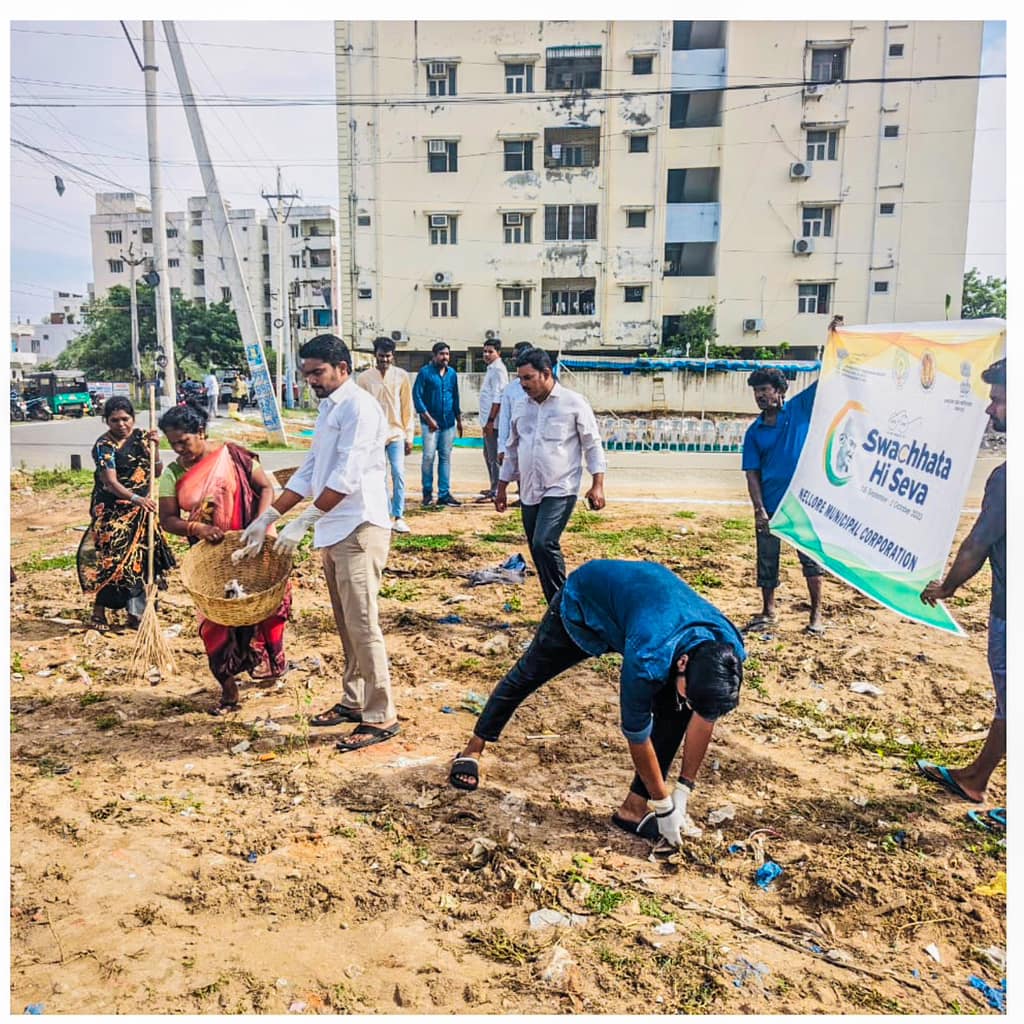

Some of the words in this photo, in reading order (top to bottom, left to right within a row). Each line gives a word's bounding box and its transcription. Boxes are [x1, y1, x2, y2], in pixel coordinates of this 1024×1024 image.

[862, 428, 952, 481] Swachhata
[869, 460, 891, 488] Hi
[888, 467, 929, 506] Seva
[798, 488, 827, 513] NELLORE
[824, 503, 861, 537] MUNICIPAL
[859, 527, 919, 573] CORPORATION
